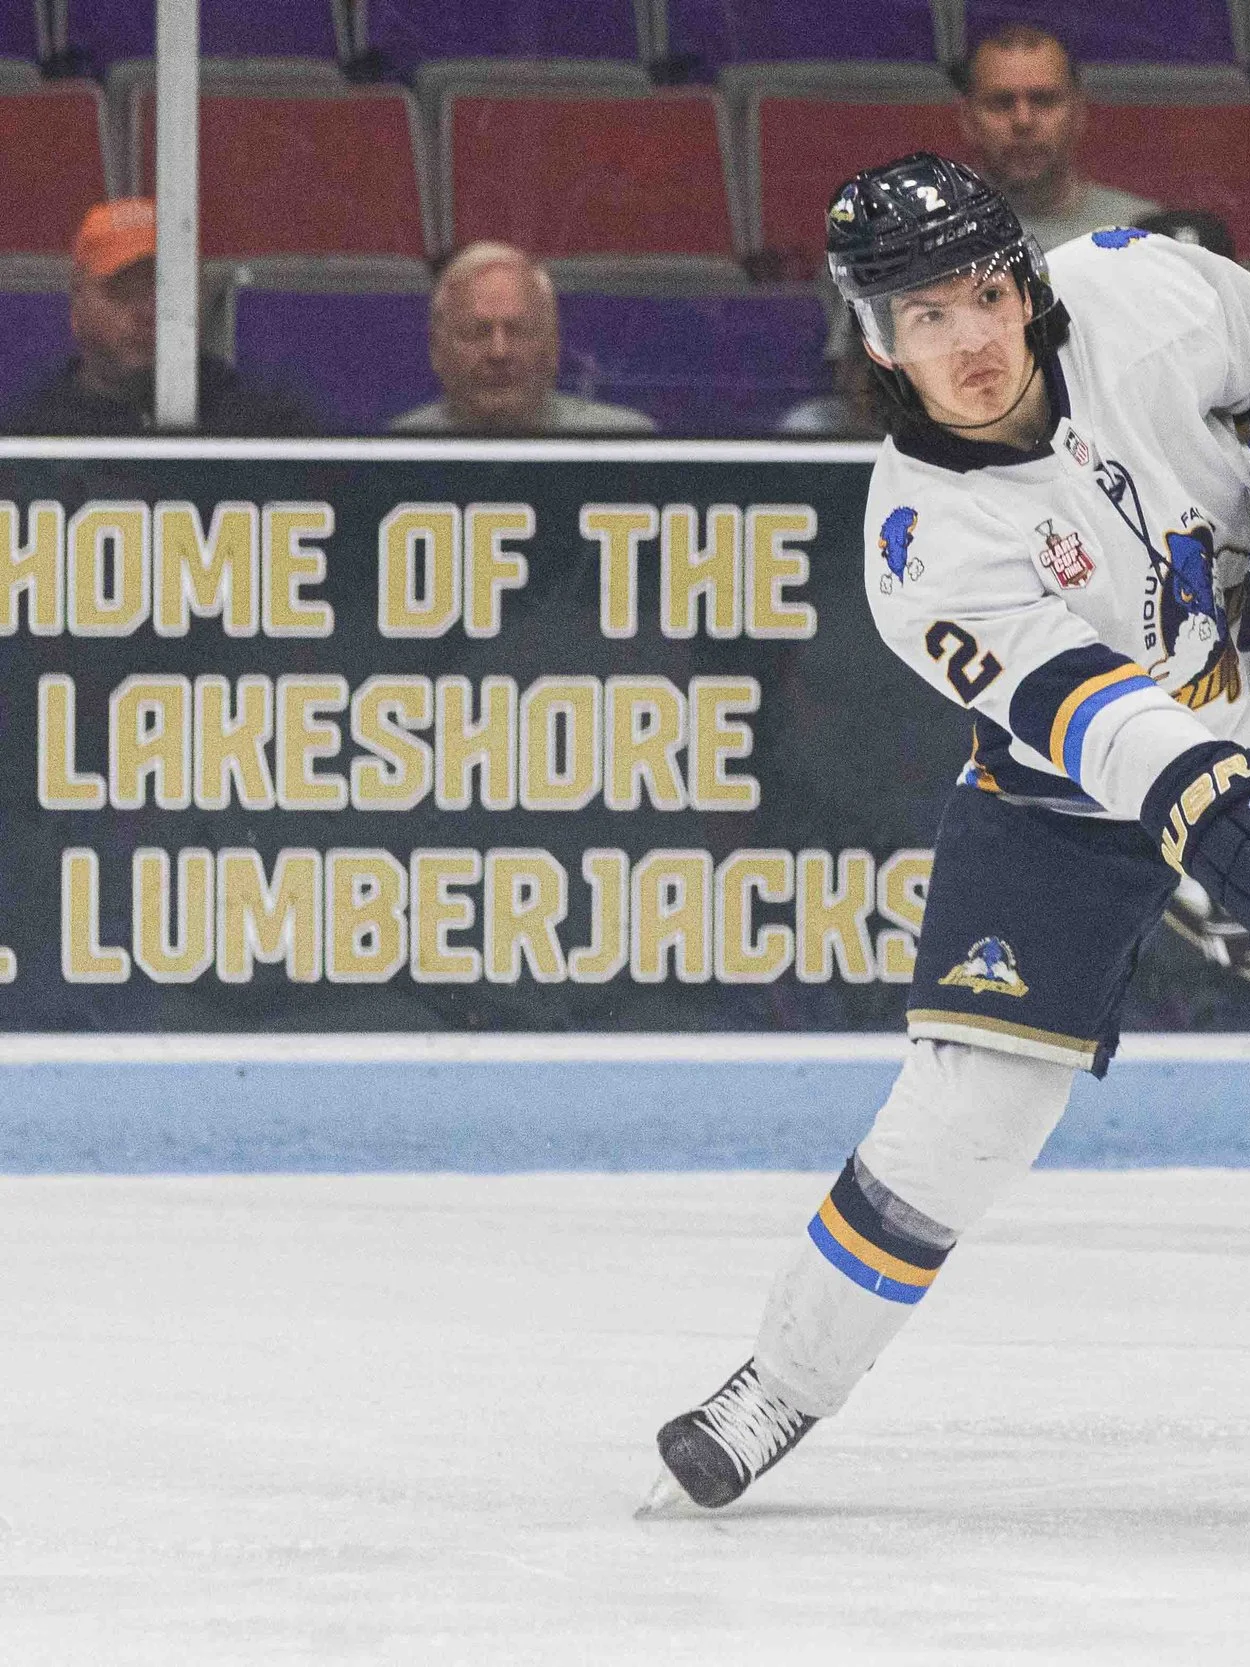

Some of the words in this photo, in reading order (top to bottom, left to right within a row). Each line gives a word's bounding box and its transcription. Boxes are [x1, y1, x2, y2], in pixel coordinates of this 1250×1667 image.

[917, 186, 946, 211] 2
[0, 500, 335, 639] HOME
[378, 501, 536, 639] OF
[579, 502, 818, 640] THE
[1040, 532, 1082, 568] CLARK
[1053, 547, 1079, 573] CUP
[1143, 563, 1158, 650] SIOU
[924, 620, 1005, 707] 2
[38, 673, 761, 811] LAKESHORE
[61, 847, 935, 984] LUMBERJACKS
